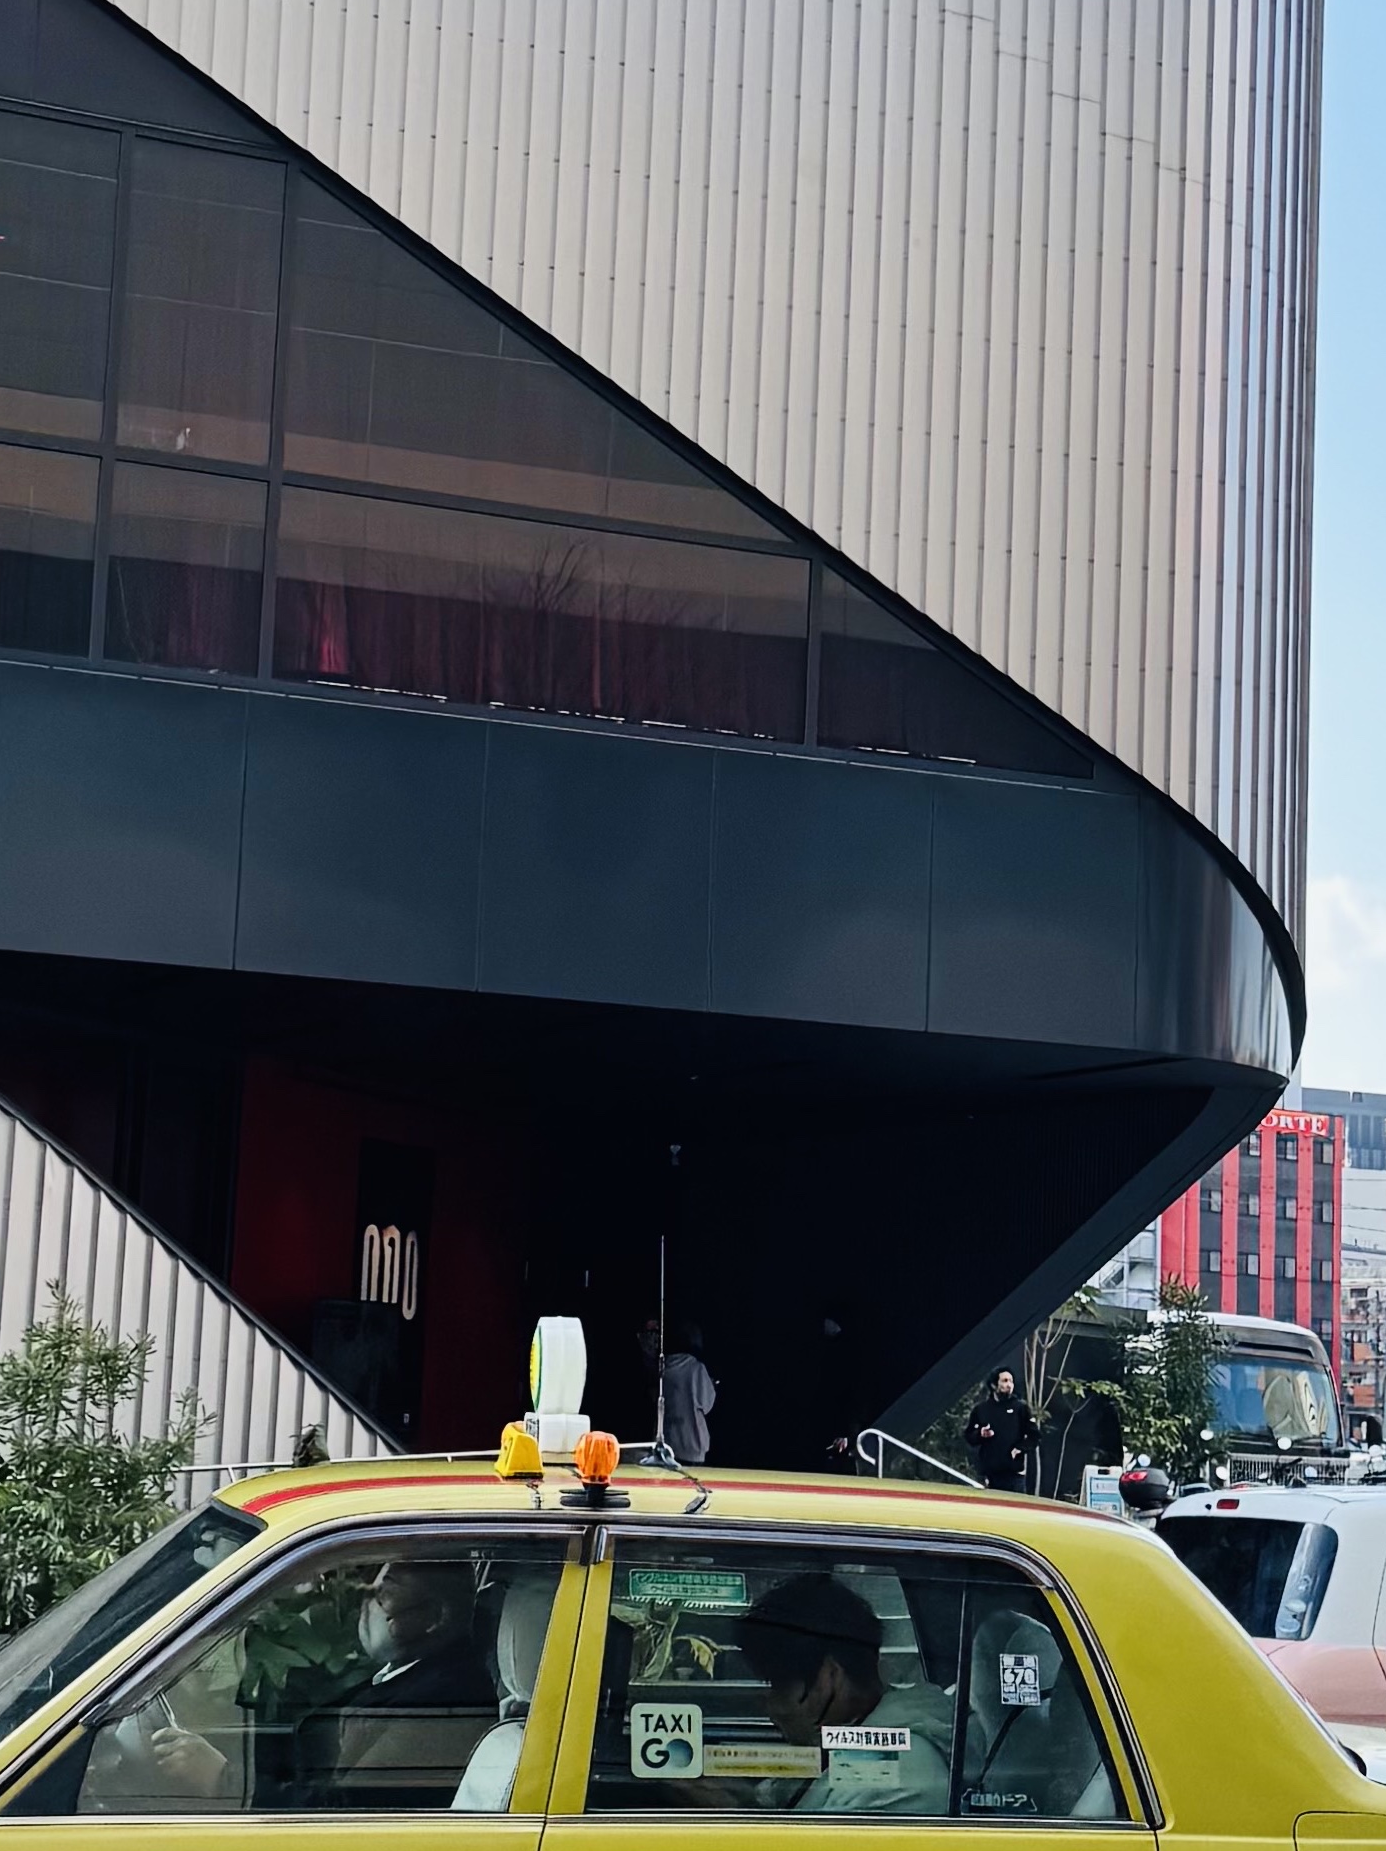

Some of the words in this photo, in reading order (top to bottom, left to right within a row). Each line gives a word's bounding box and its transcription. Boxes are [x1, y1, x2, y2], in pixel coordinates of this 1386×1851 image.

[1260, 1114, 1329, 1136] ORTE
[640, 1713, 692, 1733] TAXI
[640, 1738, 694, 1769] GO
